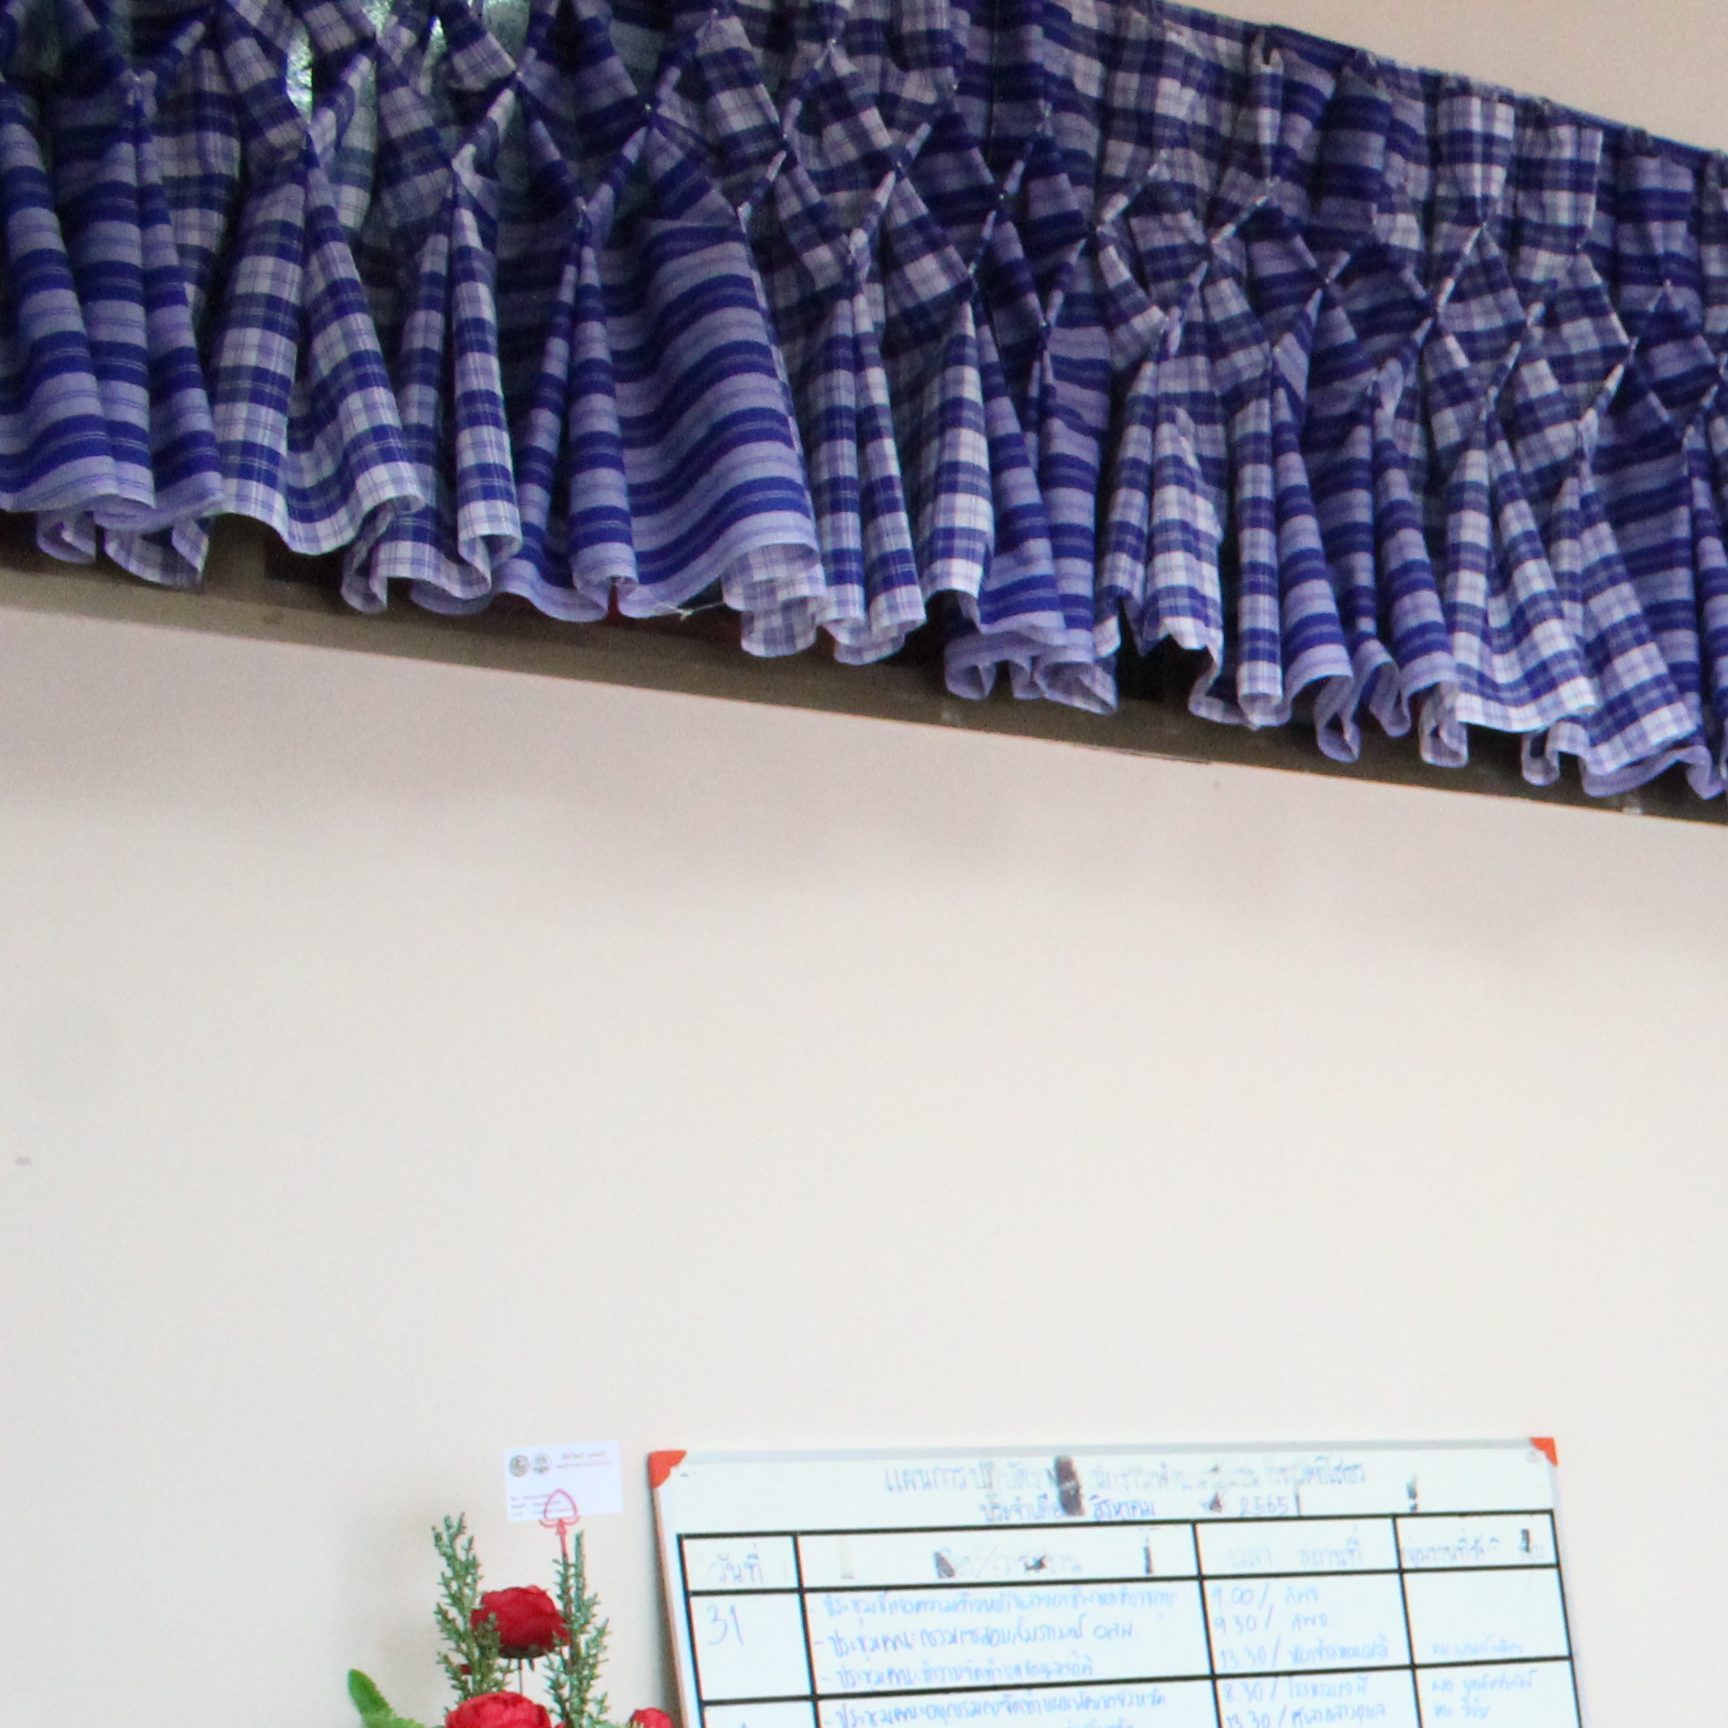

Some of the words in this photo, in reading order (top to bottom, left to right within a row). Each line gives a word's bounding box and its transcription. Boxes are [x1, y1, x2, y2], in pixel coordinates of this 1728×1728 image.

[709, 1541, 764, 1585] วันที่
[707, 1602, 745, 1648] 31
